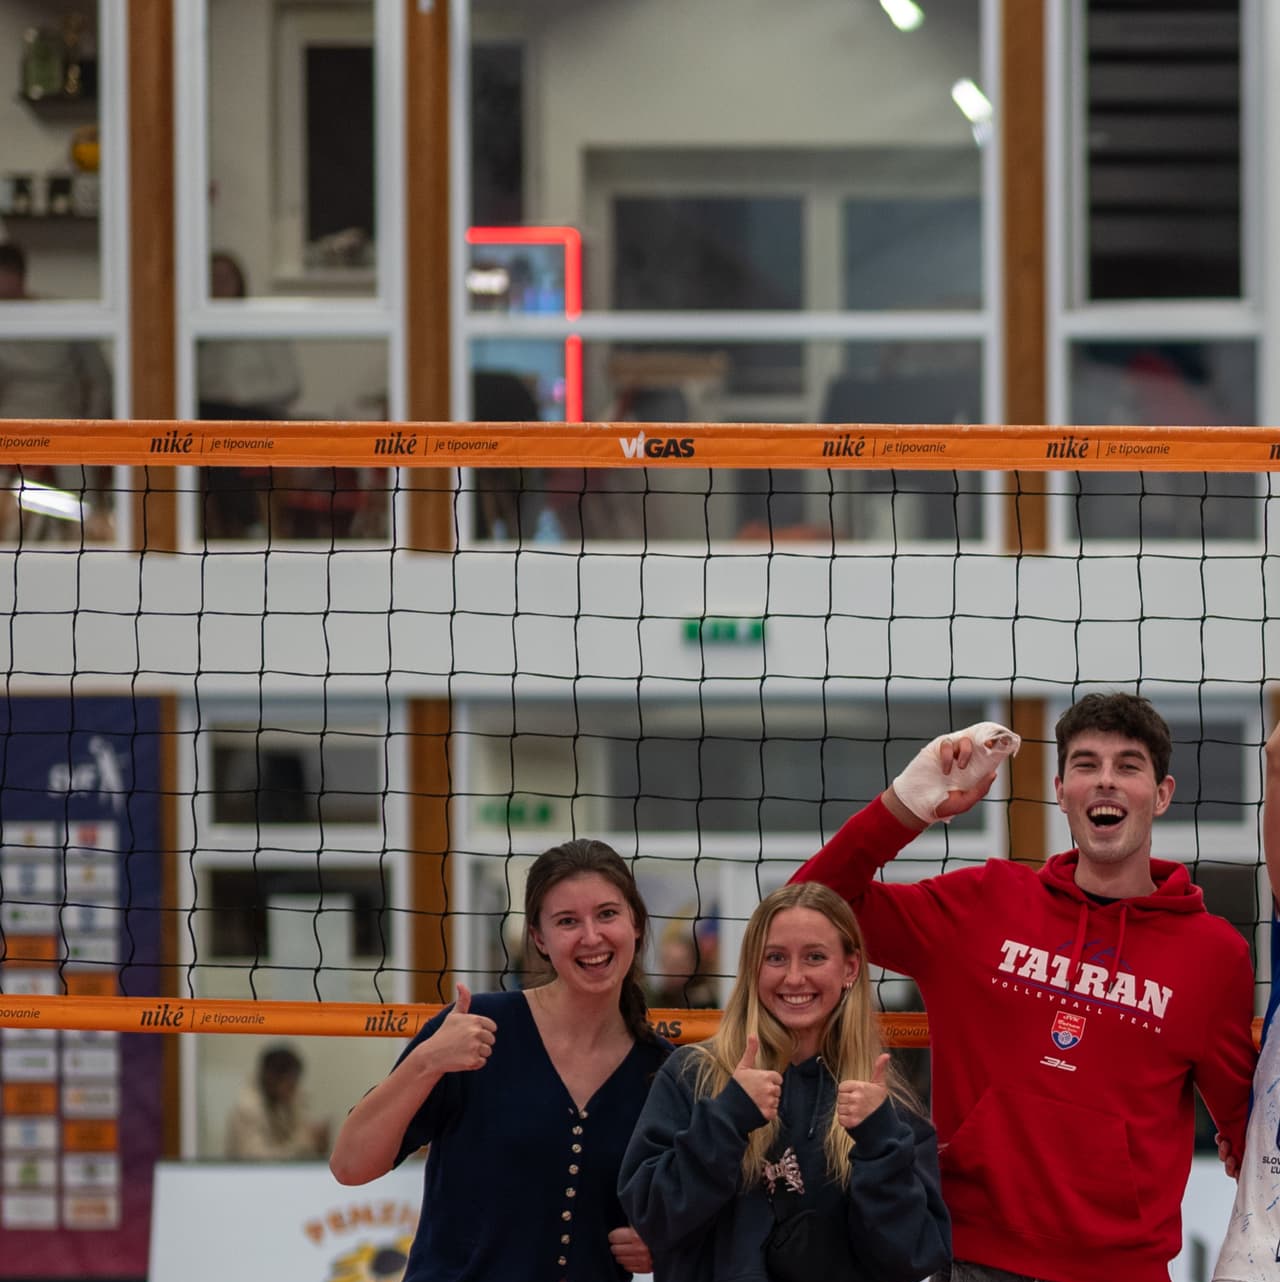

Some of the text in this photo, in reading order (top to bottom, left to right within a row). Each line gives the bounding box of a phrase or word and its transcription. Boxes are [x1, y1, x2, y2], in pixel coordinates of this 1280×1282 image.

[150, 431, 274, 453] niké je tipovanie
[375, 432, 498, 454] niké je tipovanie
[823, 434, 946, 456] niké je tipovanie
[1047, 436, 1170, 458] niké je tipovanie
[999, 939, 1173, 1019] TATRAN
[991, 977, 1161, 1034] VOLLEYBALL TEAM
[140, 1006, 265, 1028] niké je tipovanie
[364, 1010, 409, 1033] niké
